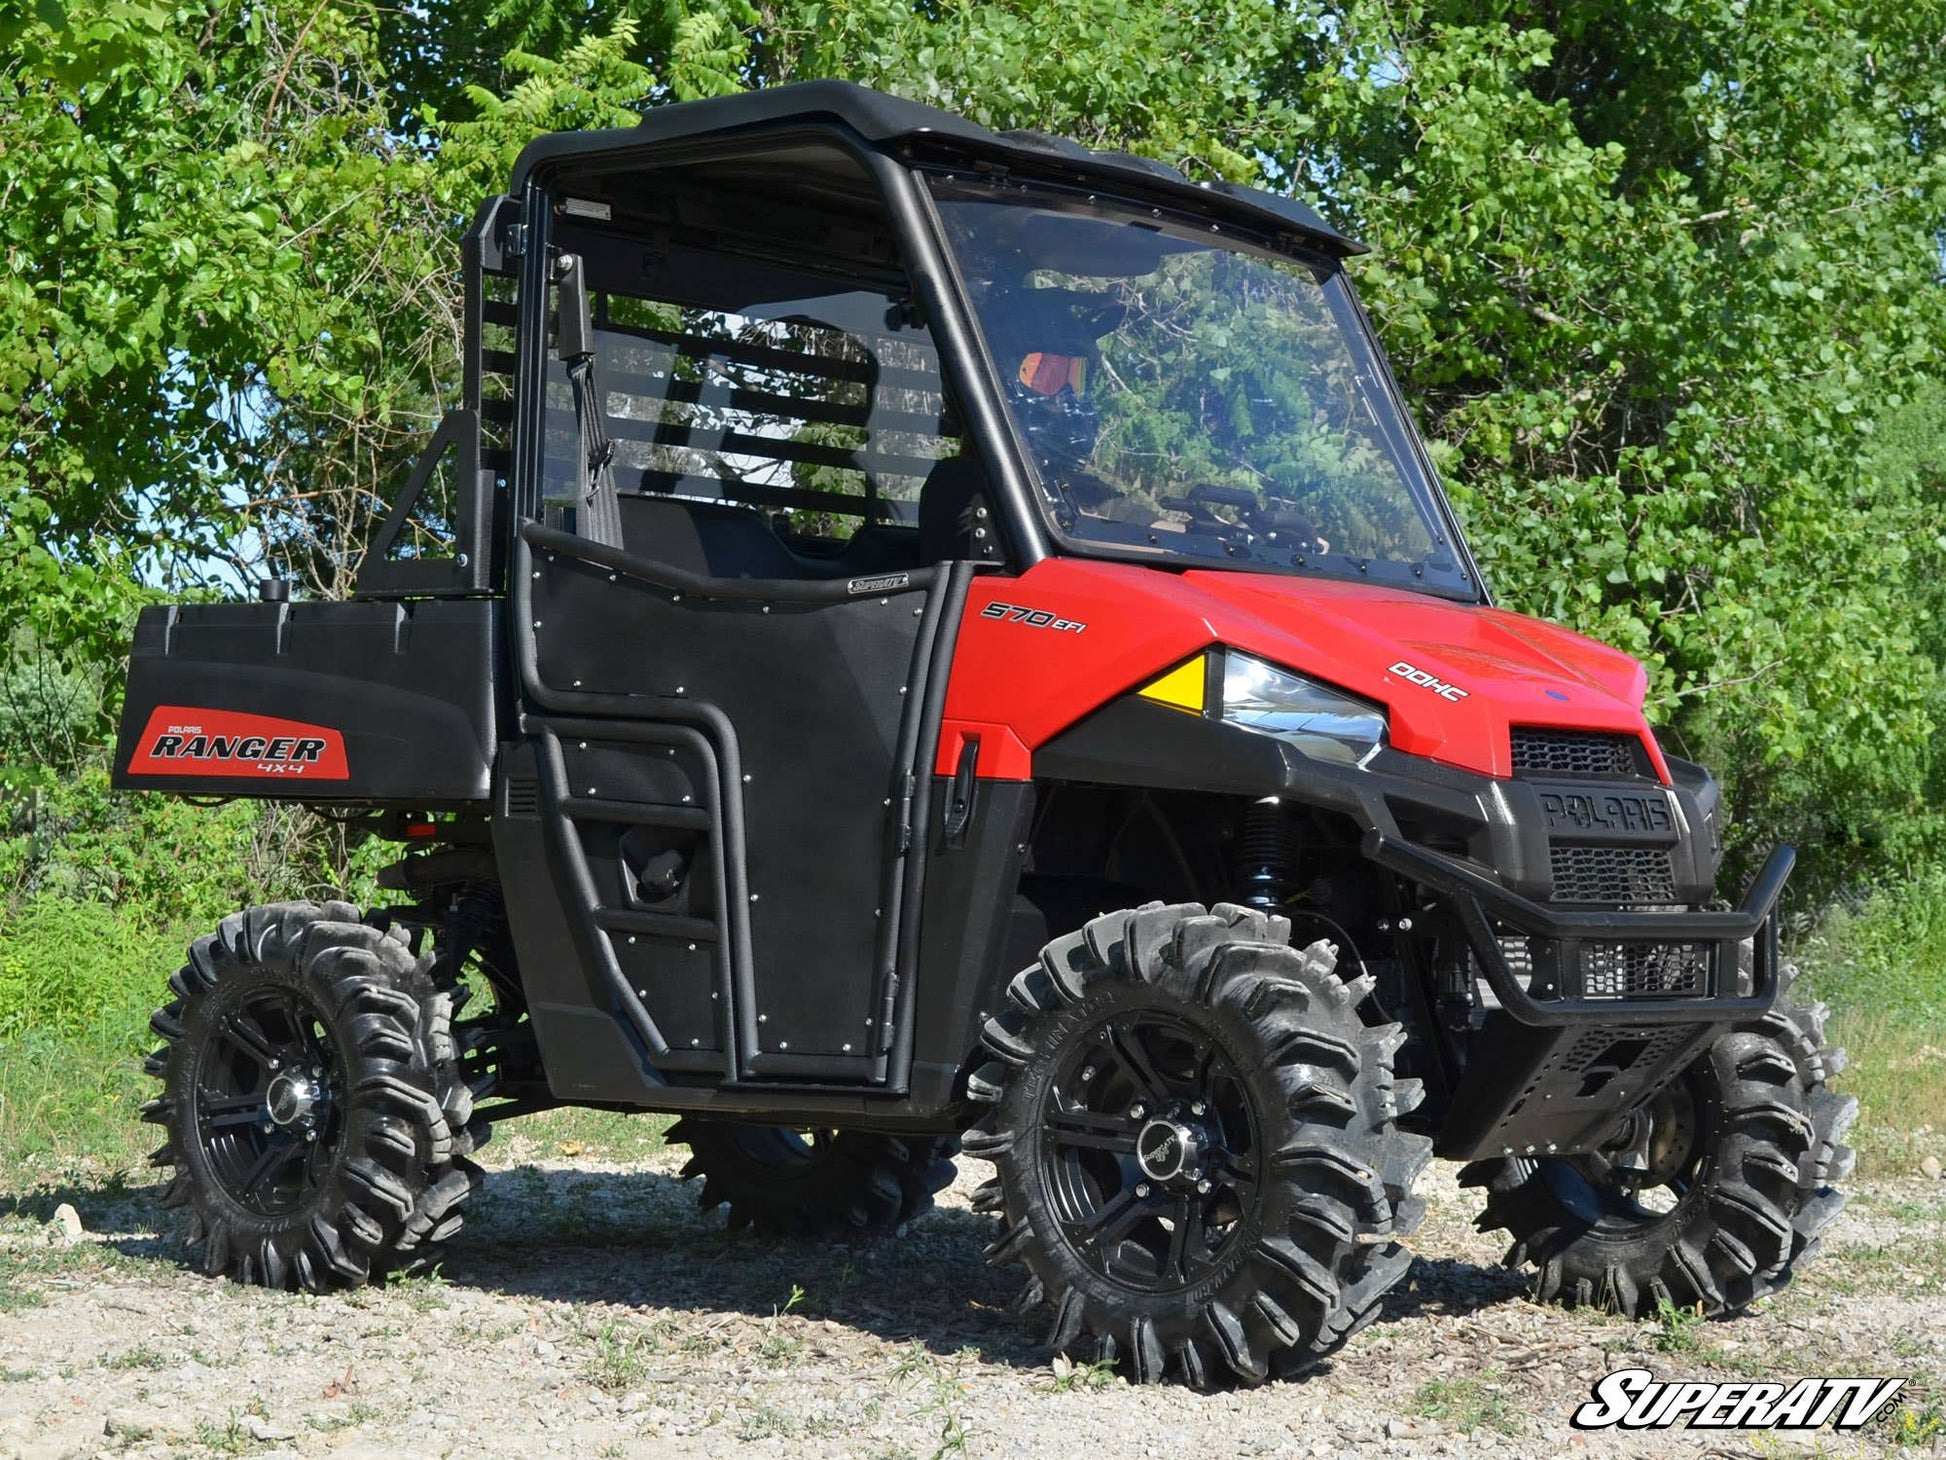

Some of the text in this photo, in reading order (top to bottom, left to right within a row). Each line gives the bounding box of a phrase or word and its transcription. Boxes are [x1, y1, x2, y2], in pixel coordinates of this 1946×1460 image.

[980, 601, 1086, 634] 570 EFI
[168, 725, 202, 734] POLARIS
[150, 735, 326, 763] RANGER
[1540, 793, 1672, 832] POLARIS
